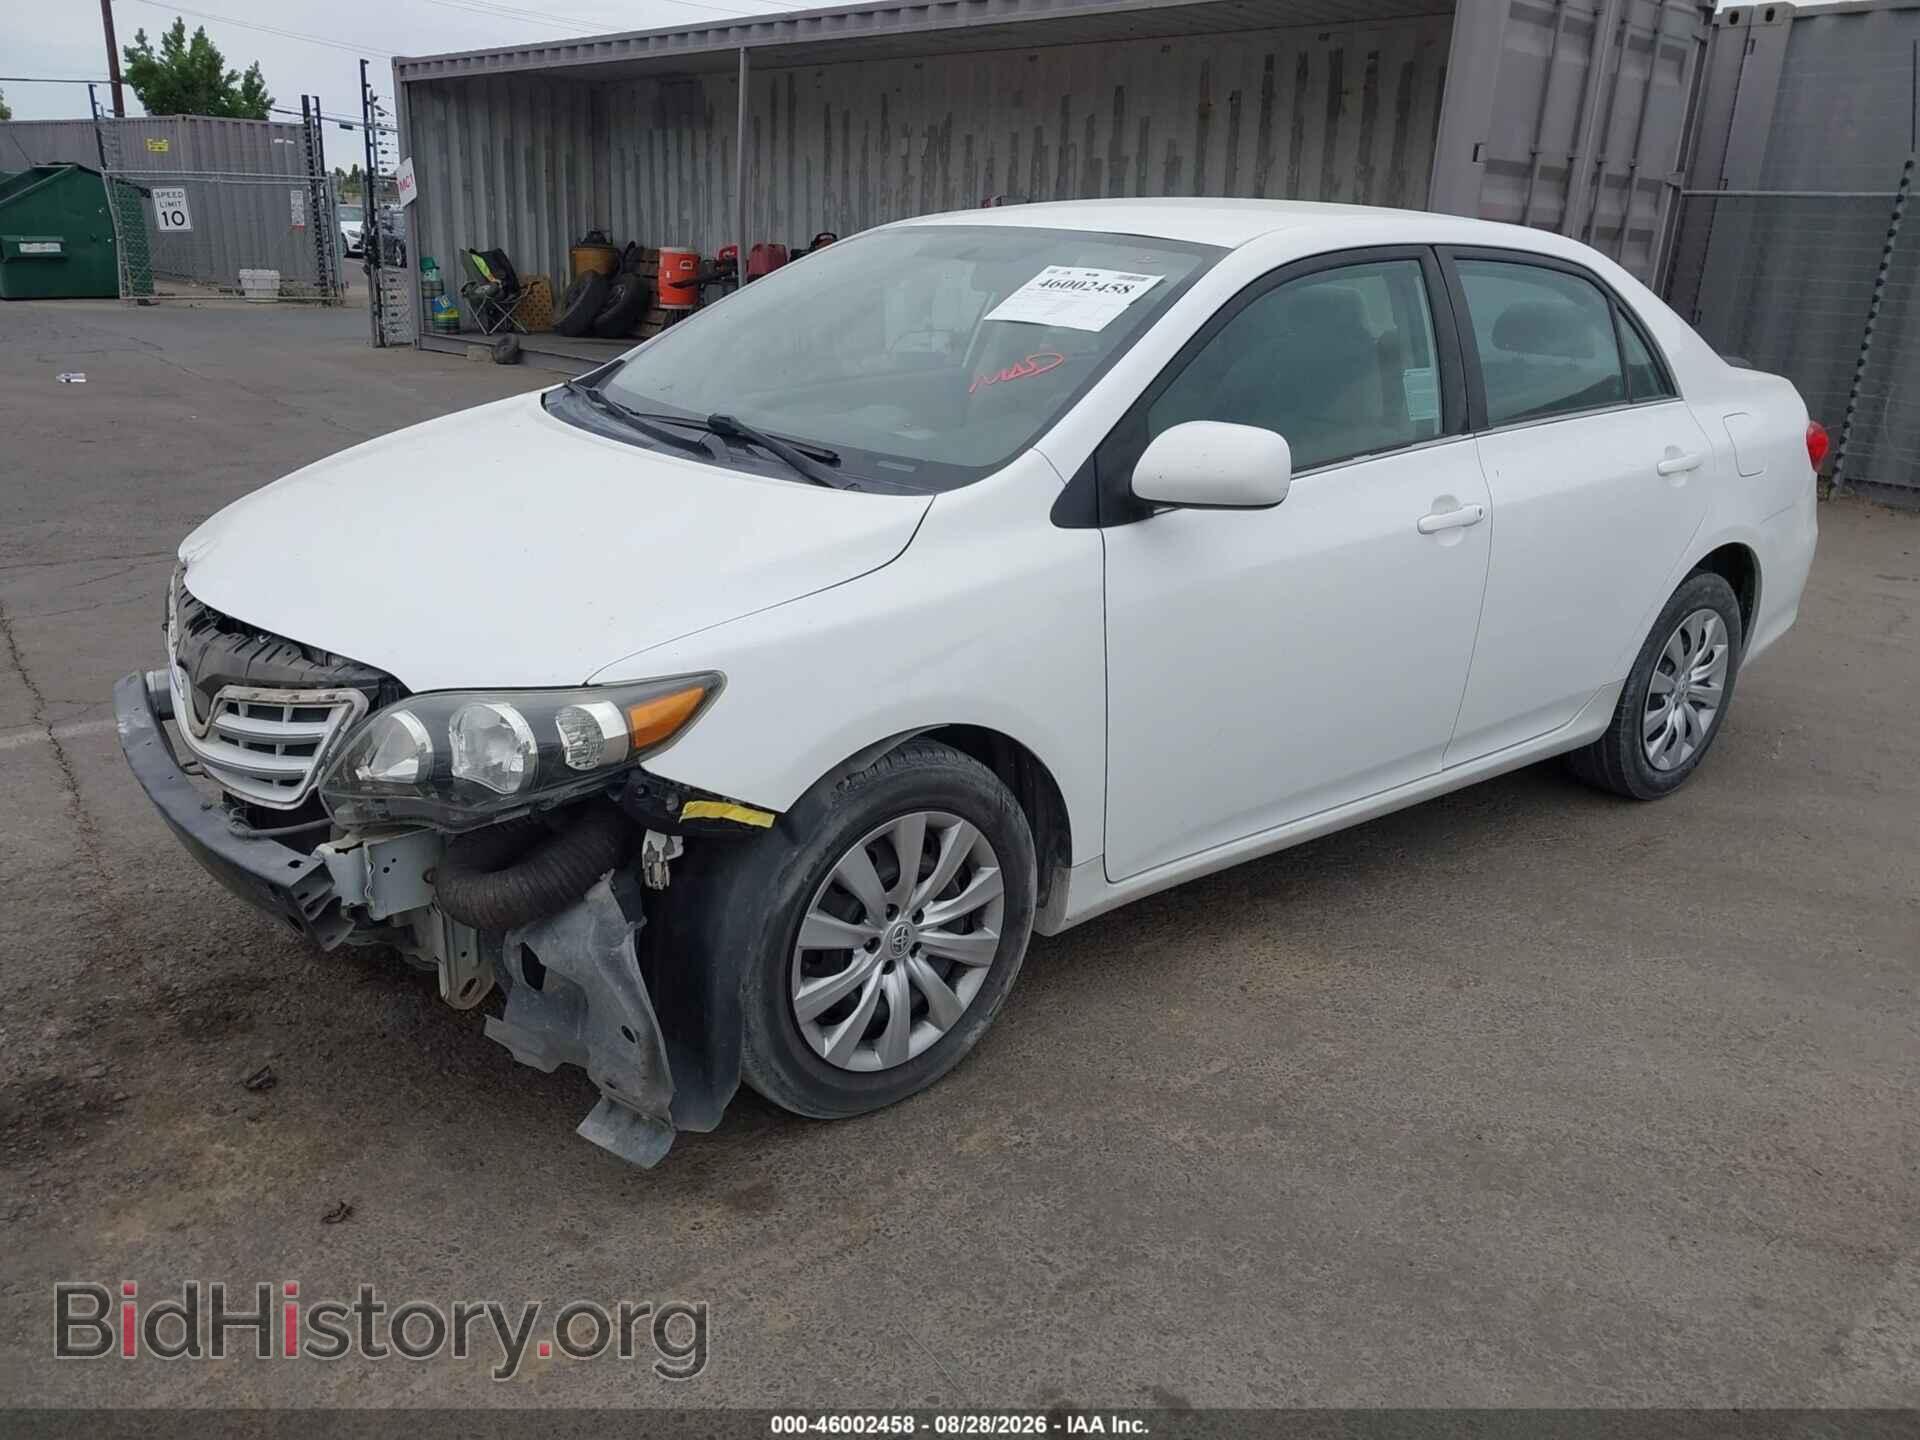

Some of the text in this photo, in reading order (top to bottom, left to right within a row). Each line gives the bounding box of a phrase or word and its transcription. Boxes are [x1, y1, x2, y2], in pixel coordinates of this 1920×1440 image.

[154, 191, 184, 199] SPEED
[161, 210, 185, 226] 10
[1038, 277, 1136, 295] 46002458
